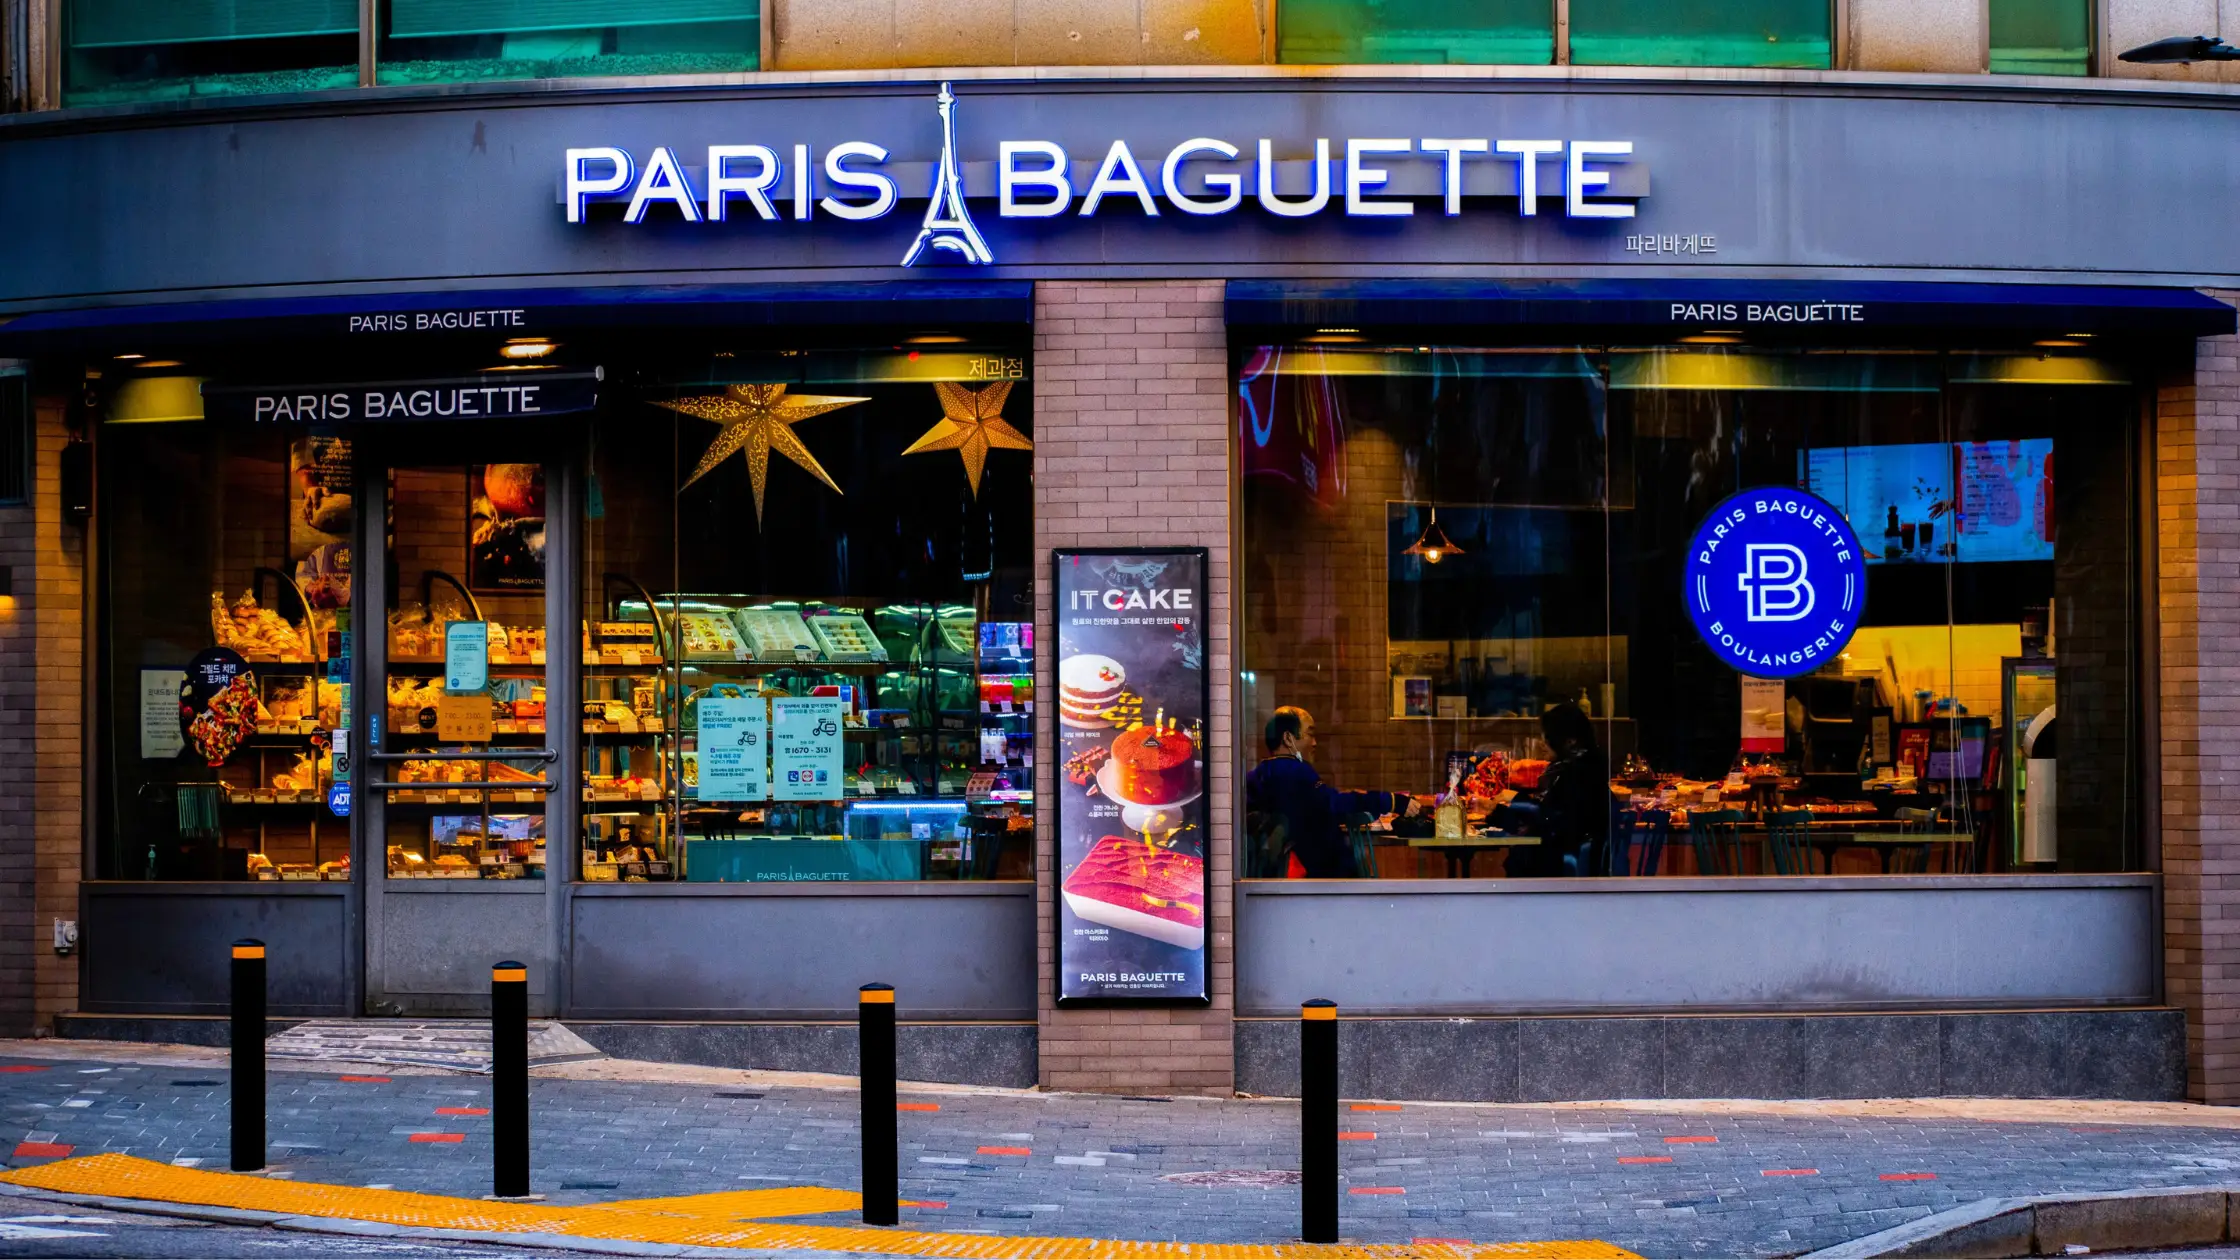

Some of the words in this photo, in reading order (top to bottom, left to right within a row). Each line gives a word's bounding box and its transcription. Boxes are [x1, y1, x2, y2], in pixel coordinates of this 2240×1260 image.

[566, 141, 898, 223] PARIS
[999, 138, 1636, 218] BAGUETTE
[1625, 233, 1718, 256] 파리바게뜨
[350, 314, 408, 332] PARIS
[415, 309, 526, 330] BAGUETTE
[1671, 303, 1738, 321] PARIS
[1746, 304, 1865, 322] BAGUETTE
[968, 357, 1024, 379] 제과점
[255, 394, 351, 422] PARIS
[364, 386, 542, 419] BAGUETTE
[1700, 508, 1747, 565] PARIS
[1755, 499, 1852, 564] BAGUETTE
[1071, 589, 1099, 610] IT
[1102, 588, 1193, 611] CAKE
[1120, 617, 1141, 625] 그대로
[1141, 616, 1155, 625] 살린
[1710, 618, 1845, 667] BOULANGERIE
[199, 664, 221, 674] 그릴드
[222, 663, 237, 674] 치킨
[148, 688, 178, 696] 안내드립니
[815, 746, 832, 754] 3131
[332, 793, 351, 806] ADT
[756, 872, 788, 881] PARIS
[795, 872, 850, 881] BAGUETTE
[1080, 972, 1117, 982] PARIS
[1120, 972, 1186, 982] BAGUETTE
